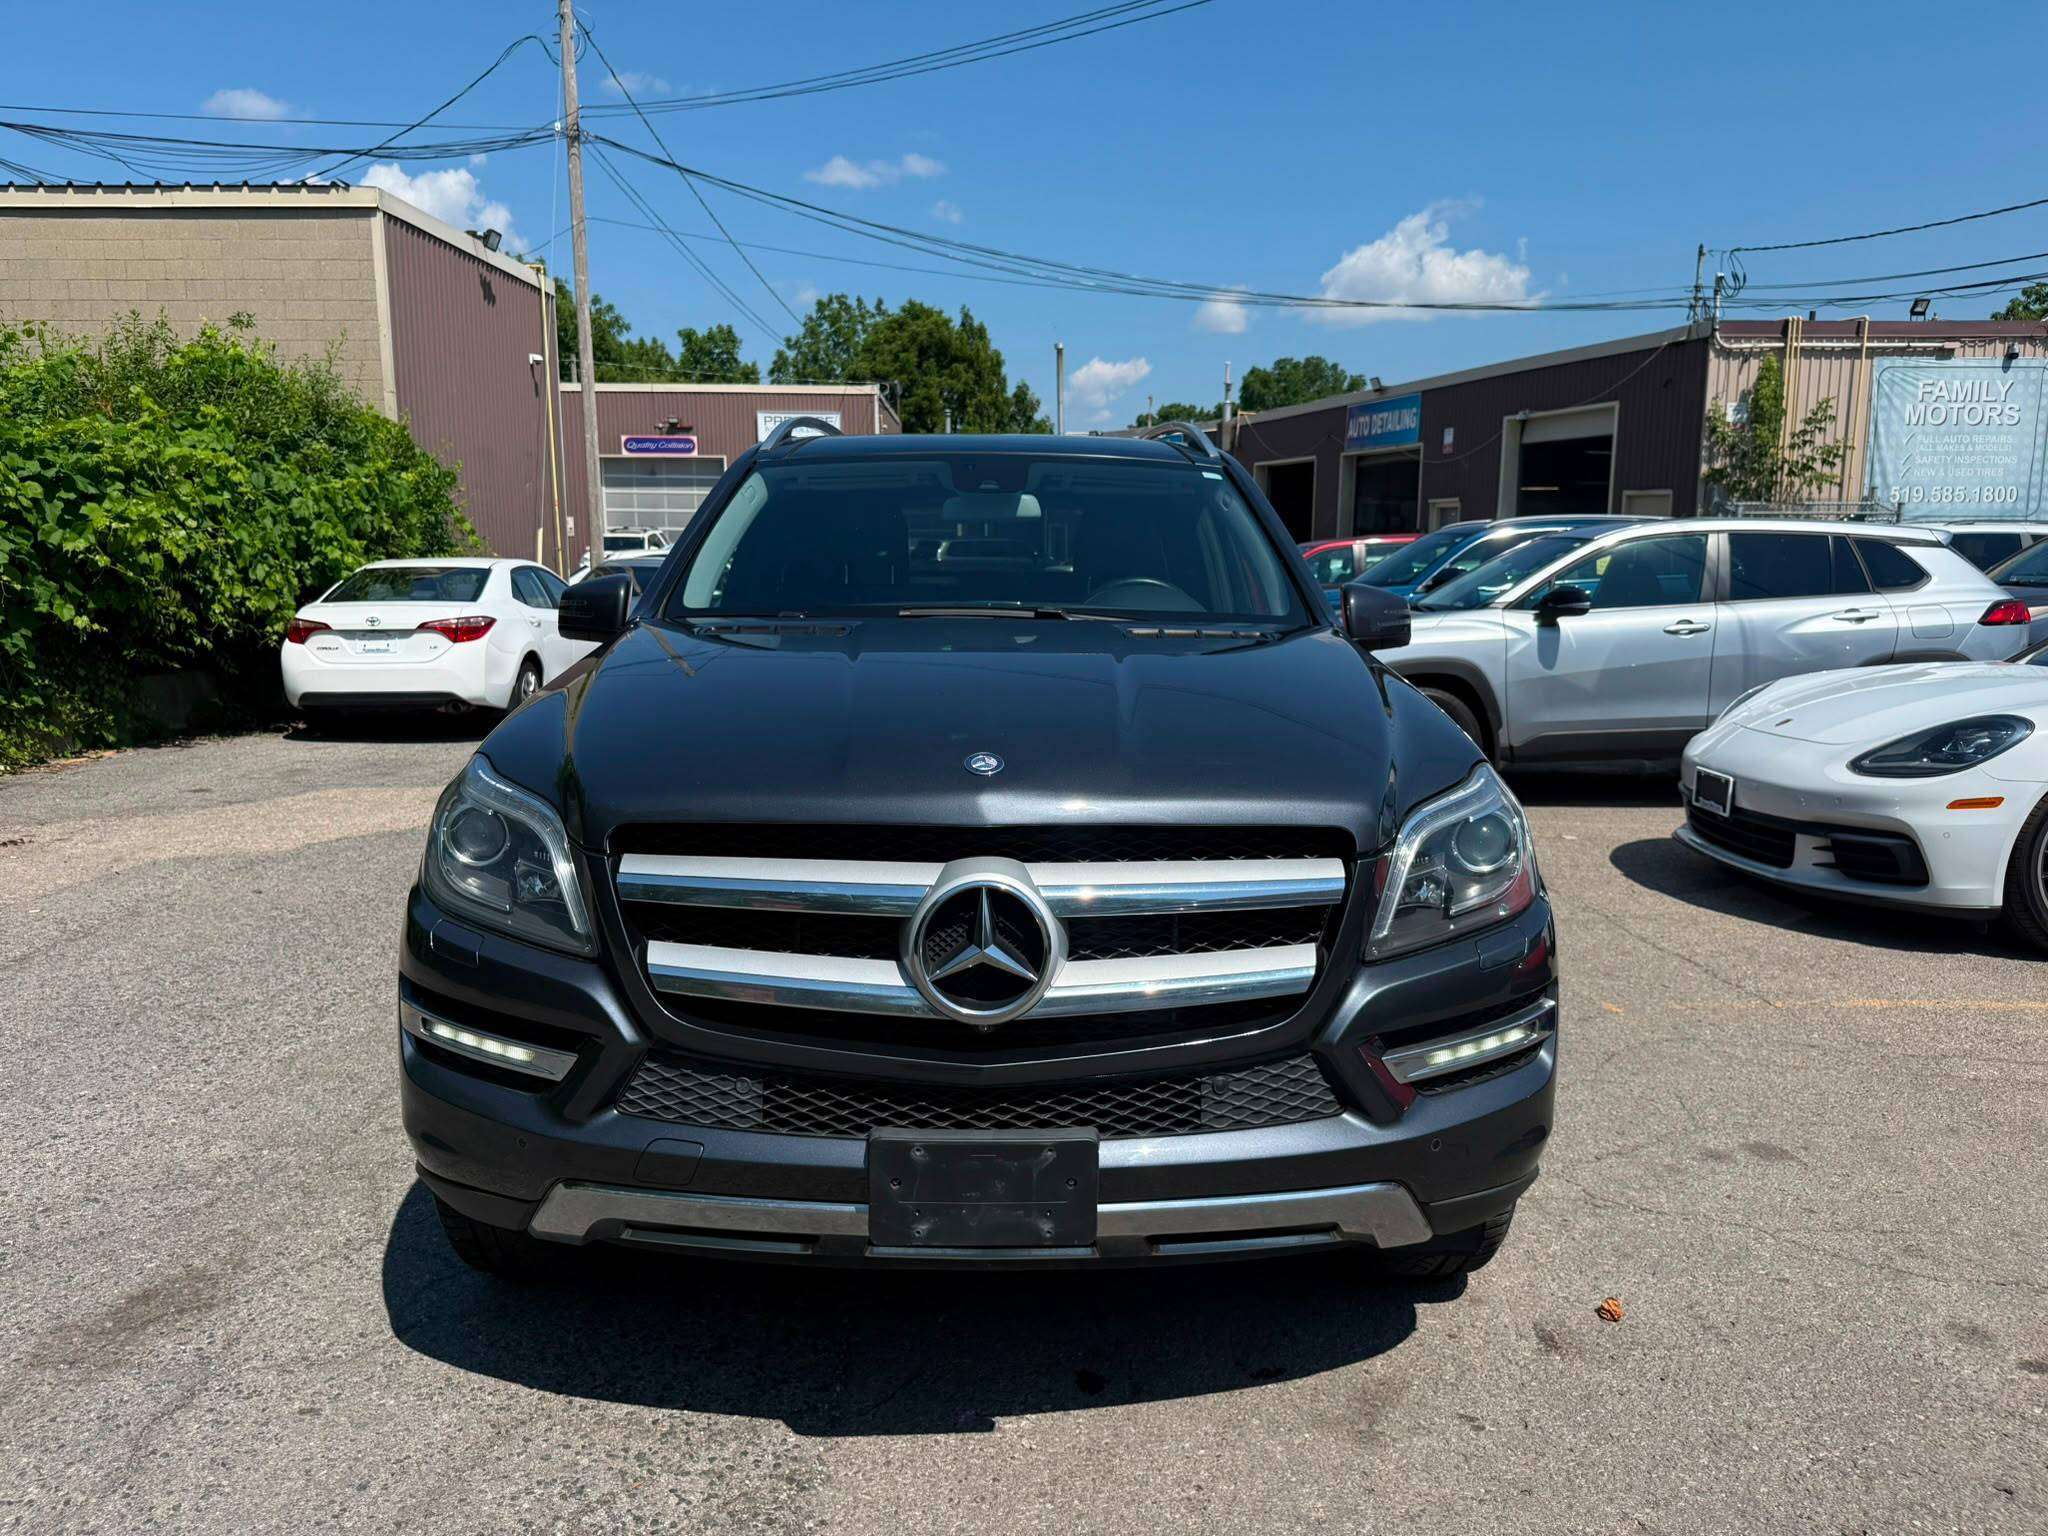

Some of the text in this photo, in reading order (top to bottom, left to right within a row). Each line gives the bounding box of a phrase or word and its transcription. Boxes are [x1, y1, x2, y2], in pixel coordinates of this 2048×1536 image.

[1919, 380, 2014, 403] FAMILY
[1905, 403, 2021, 426] MOTORS
[1347, 408, 1417, 439] AUTO DETAILING
[626, 440, 694, 450] Quality Collision
[1916, 434, 2012, 444] FULL AUTO REPAIRS
[1915, 455, 2018, 464] SAFETY INSPECTIONS
[1914, 468, 1936, 476] NEW
[1949, 467, 1974, 476] USED
[1976, 467, 2005, 476] TIRES
[1889, 485, 2019, 503] 519.585.1800
